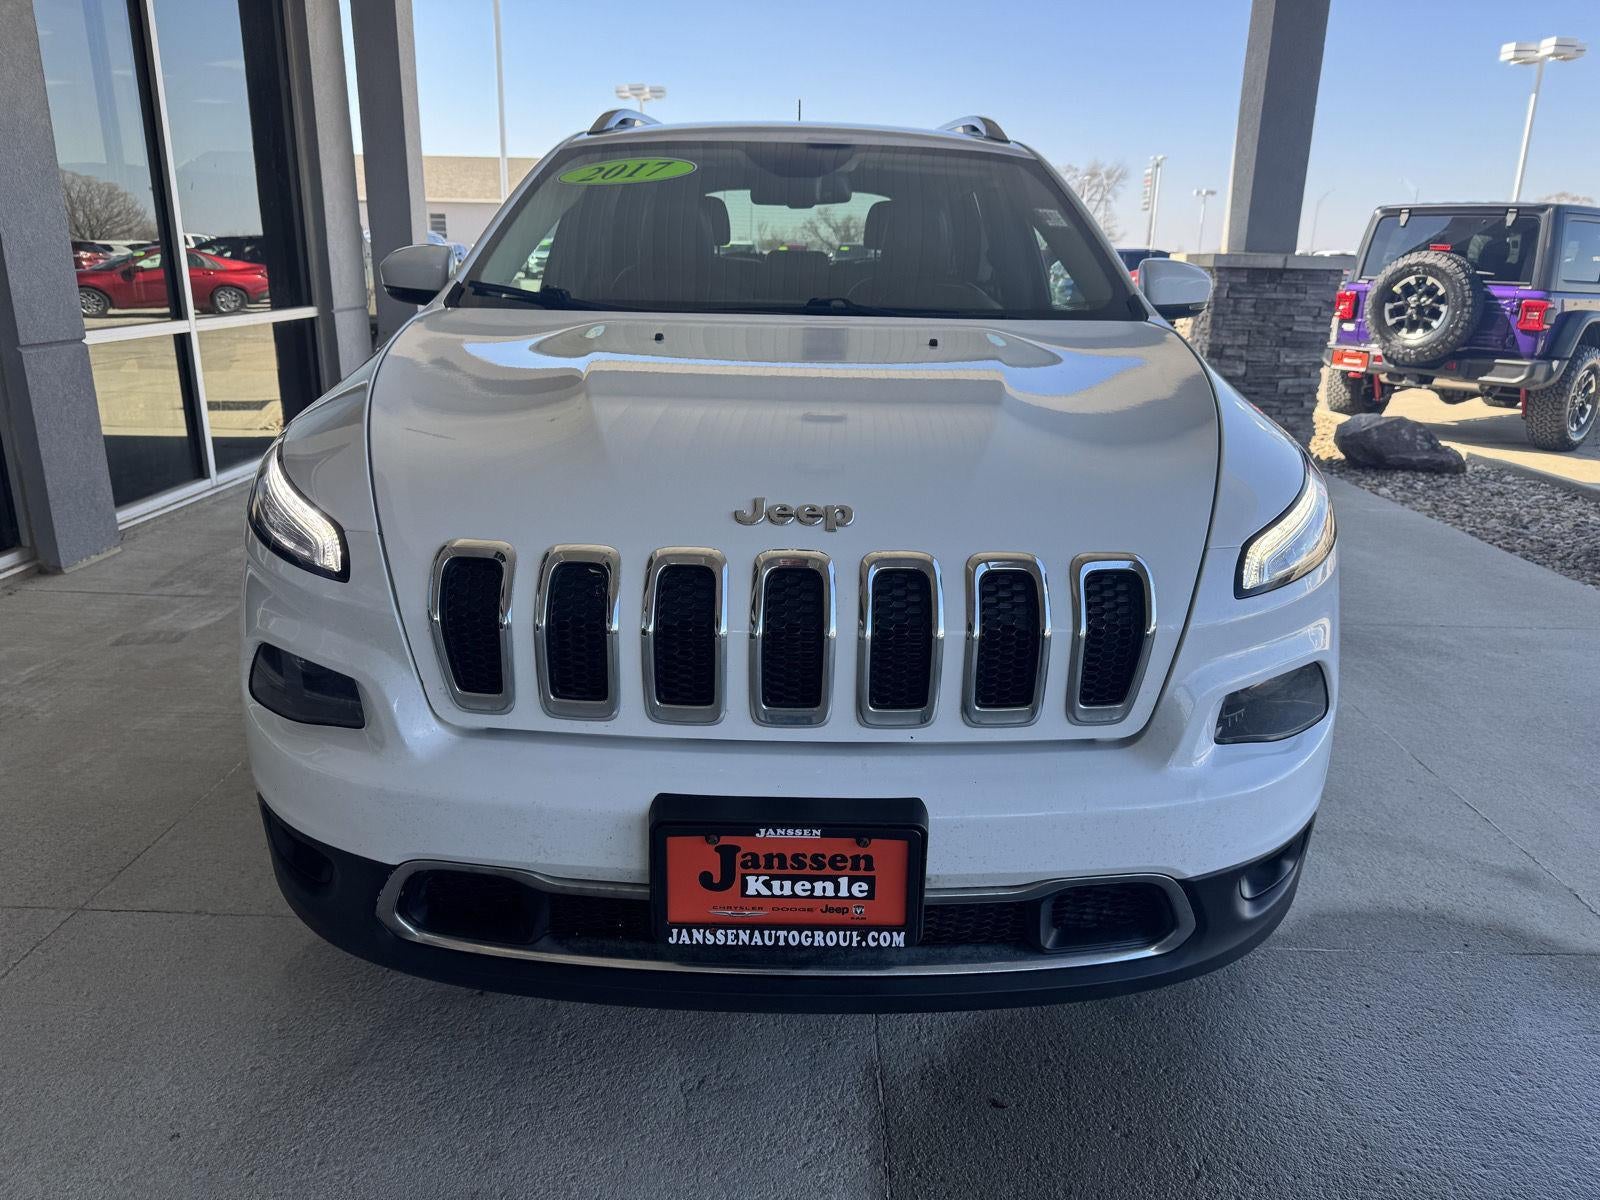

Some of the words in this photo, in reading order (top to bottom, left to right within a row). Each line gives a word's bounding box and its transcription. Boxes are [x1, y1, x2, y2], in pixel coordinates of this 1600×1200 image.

[576, 161, 675, 182] 2017
[734, 497, 855, 532] Jeep
[755, 828, 822, 838] JANSSEN
[698, 844, 875, 892] Janssen
[745, 875, 869, 898] Kuenle
[819, 904, 850, 915] Jeep
